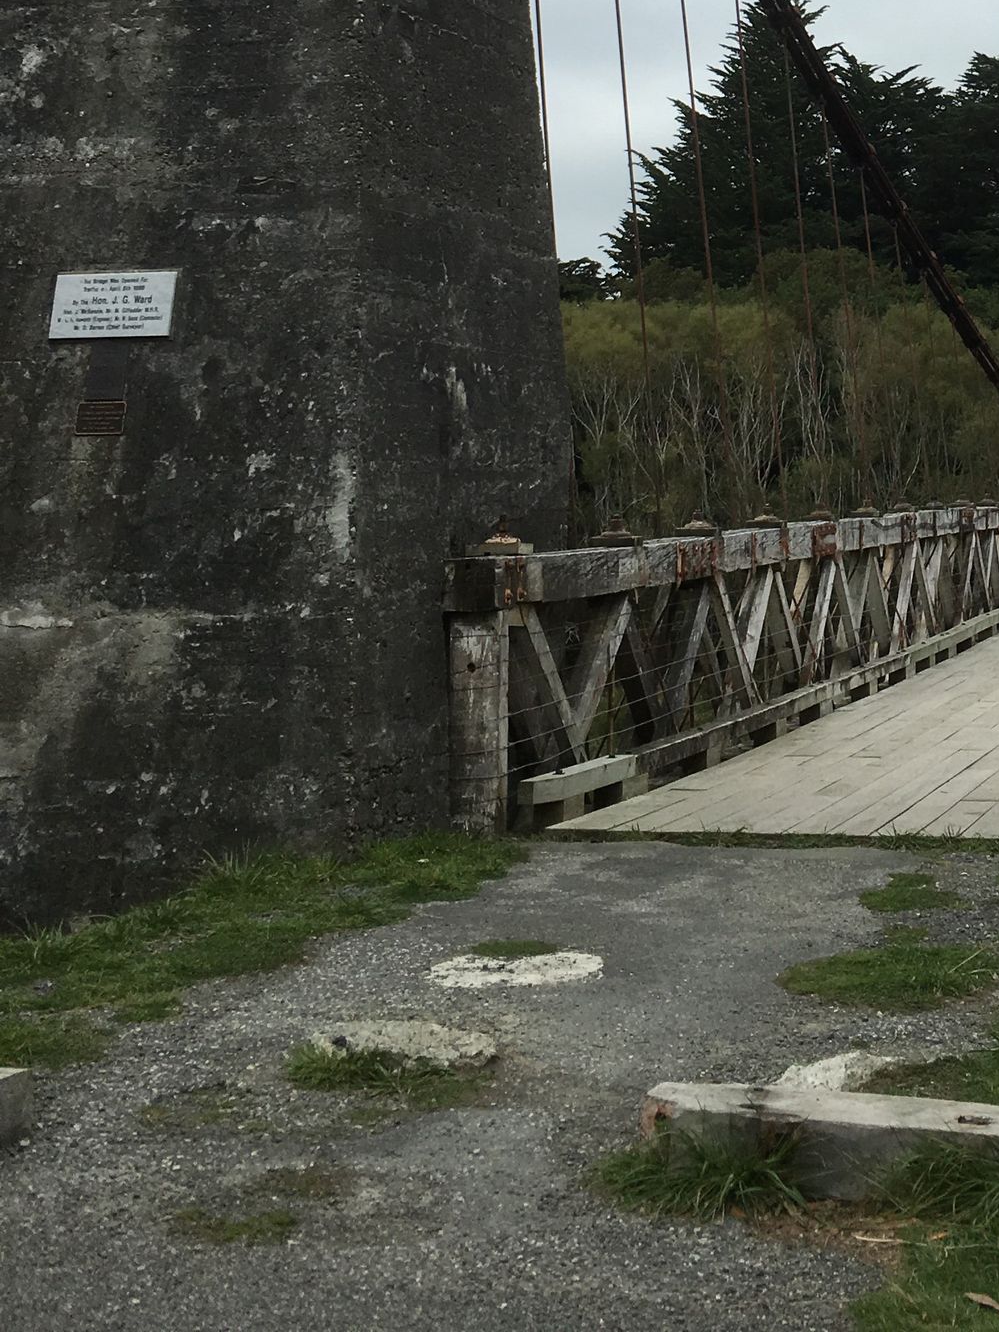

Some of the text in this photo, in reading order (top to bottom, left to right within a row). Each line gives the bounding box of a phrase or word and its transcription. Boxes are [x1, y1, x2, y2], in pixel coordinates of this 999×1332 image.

[112, 295, 118, 304] J.
[122, 295, 130, 304] G.
[134, 294, 152, 304] Ward
